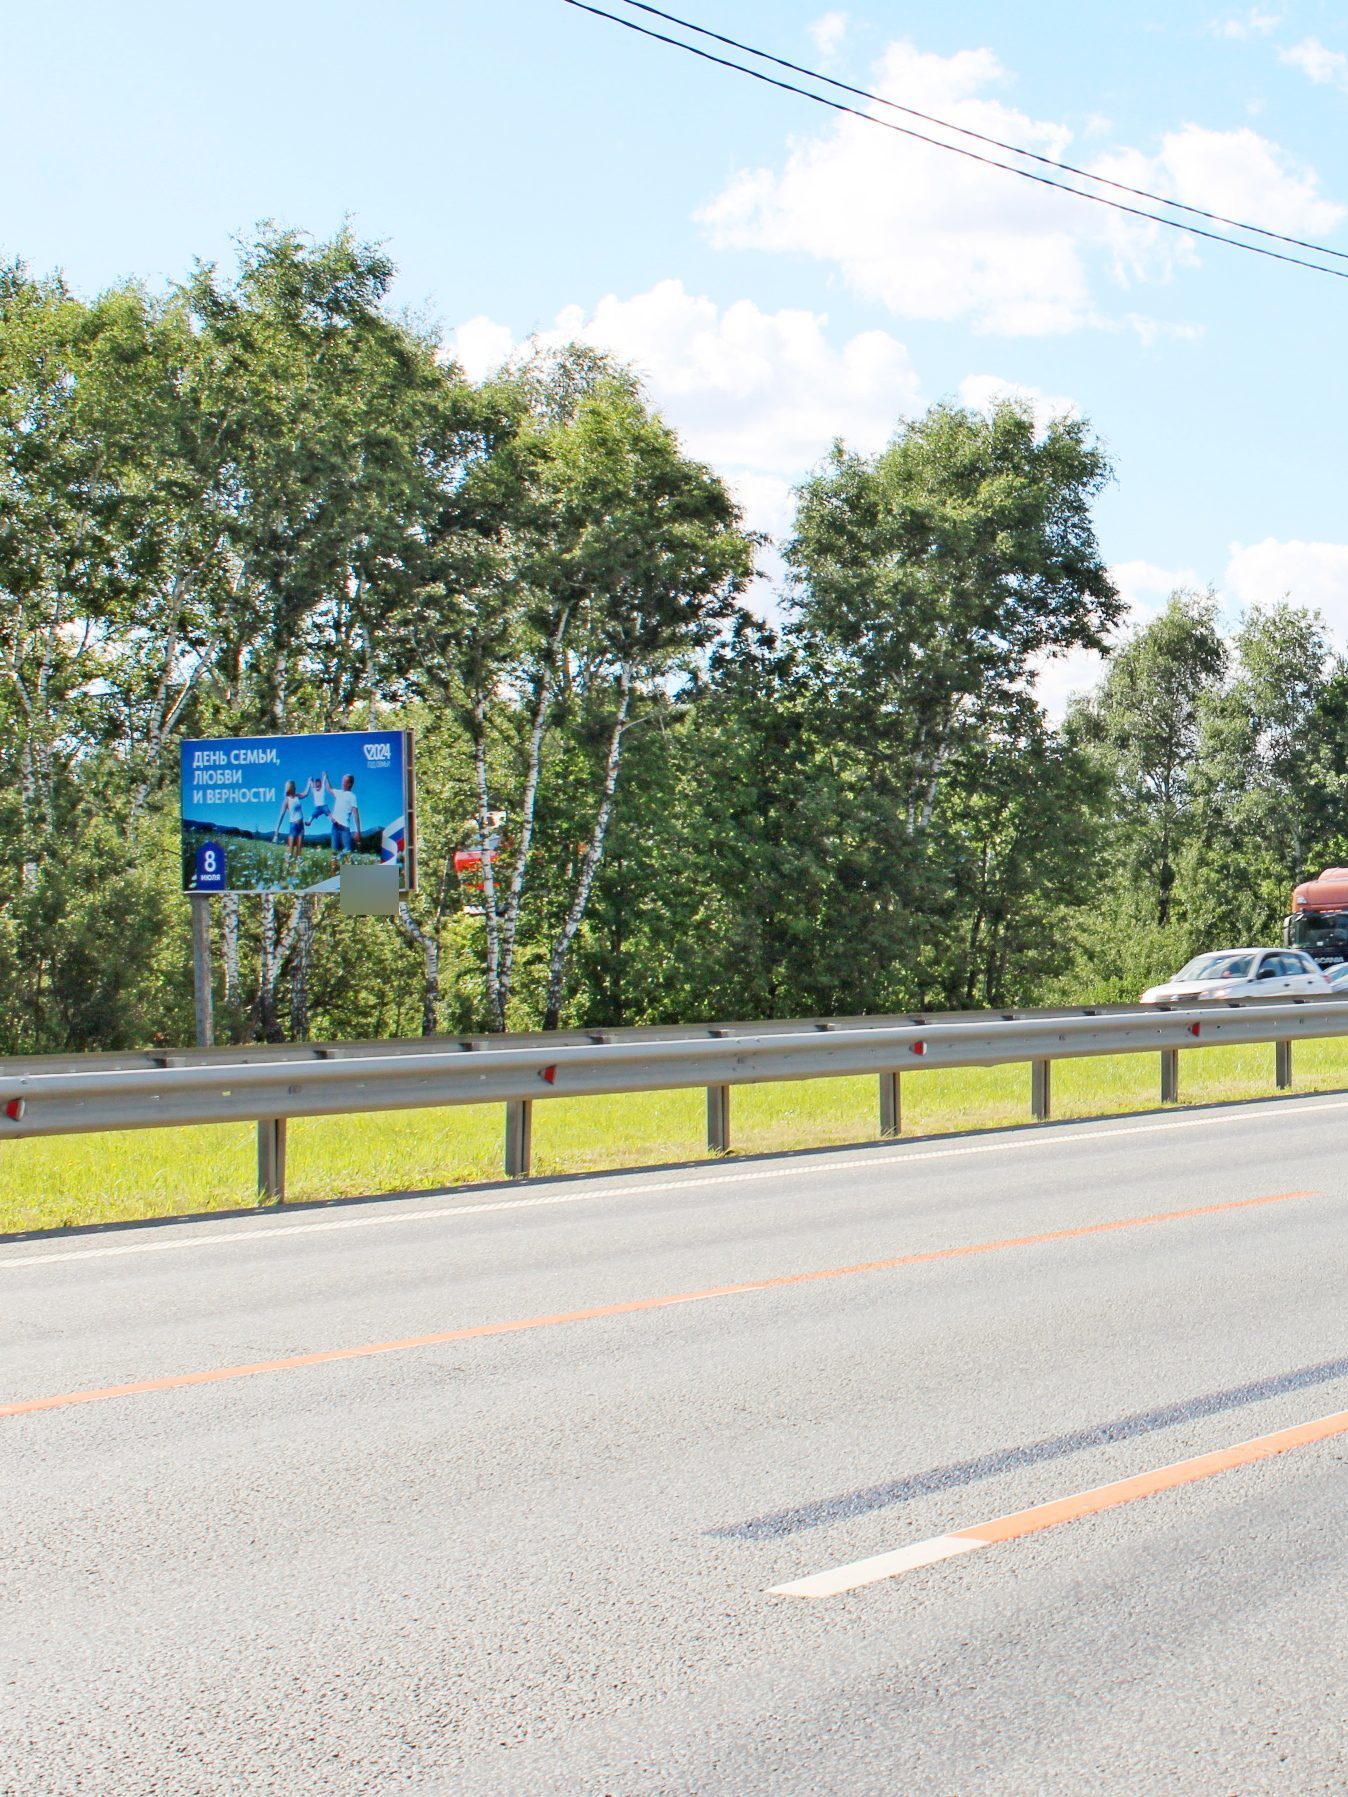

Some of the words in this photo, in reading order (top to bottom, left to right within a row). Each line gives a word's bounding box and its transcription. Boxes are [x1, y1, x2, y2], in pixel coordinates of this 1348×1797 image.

[193, 750, 228, 768] ДЕНЬ
[230, 748, 280, 766] СЕМЬИ,
[367, 743, 391, 760] 2024
[193, 769, 242, 785] ЛЮБВИ
[193, 789, 203, 804] И
[206, 787, 276, 804] ВЕРНОСТИ
[204, 850, 216, 873] 8
